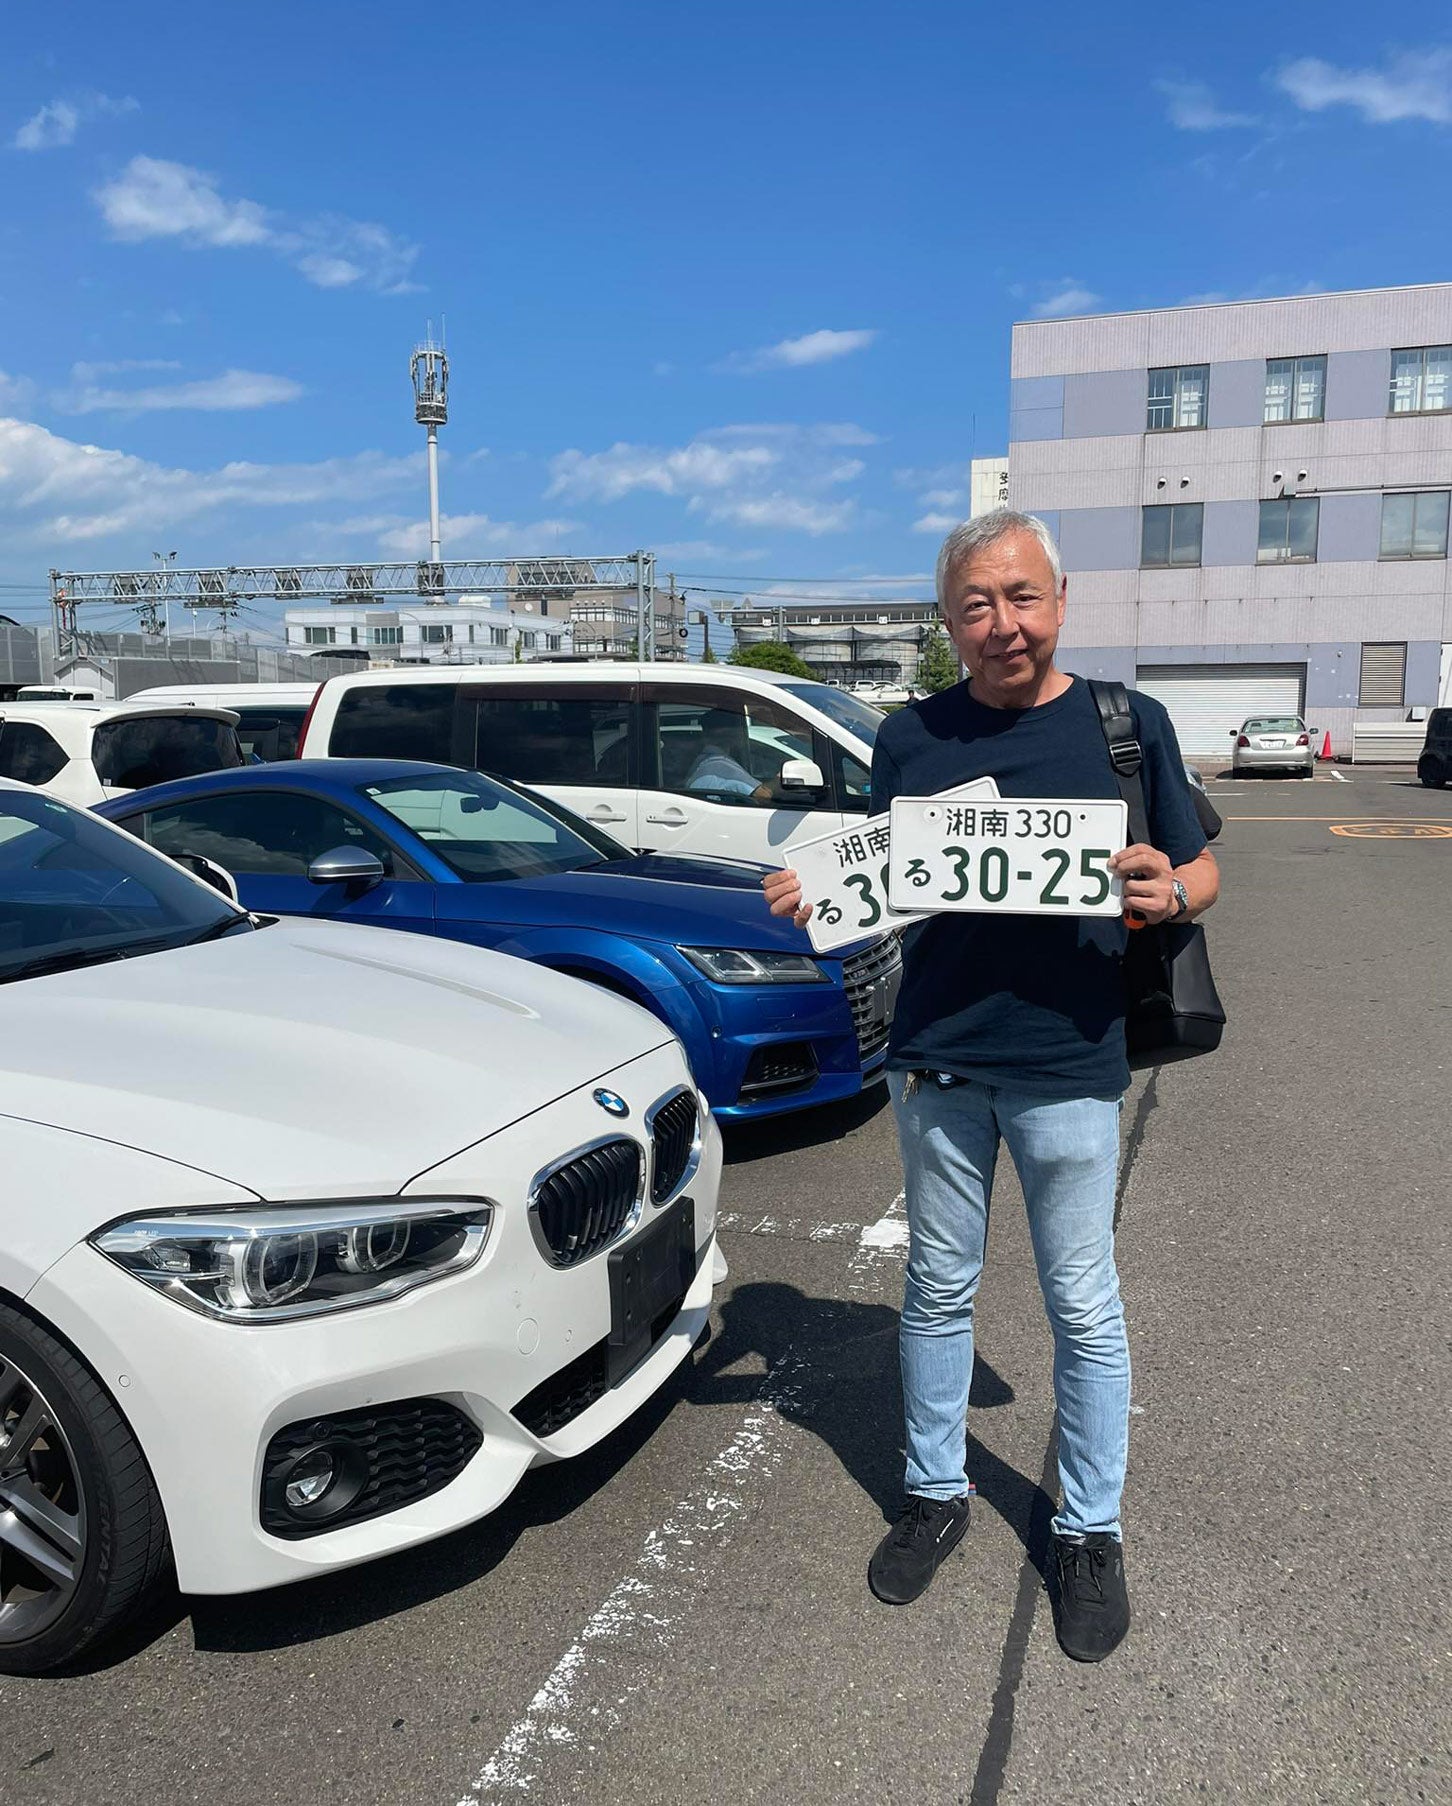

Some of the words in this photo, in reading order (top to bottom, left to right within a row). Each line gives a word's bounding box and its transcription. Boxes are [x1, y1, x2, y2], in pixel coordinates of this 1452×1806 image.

[833, 831, 890, 868] 湘南
[904, 858, 932, 888] る
[940, 845, 1111, 906] 30-25
[816, 898, 843, 925] る
